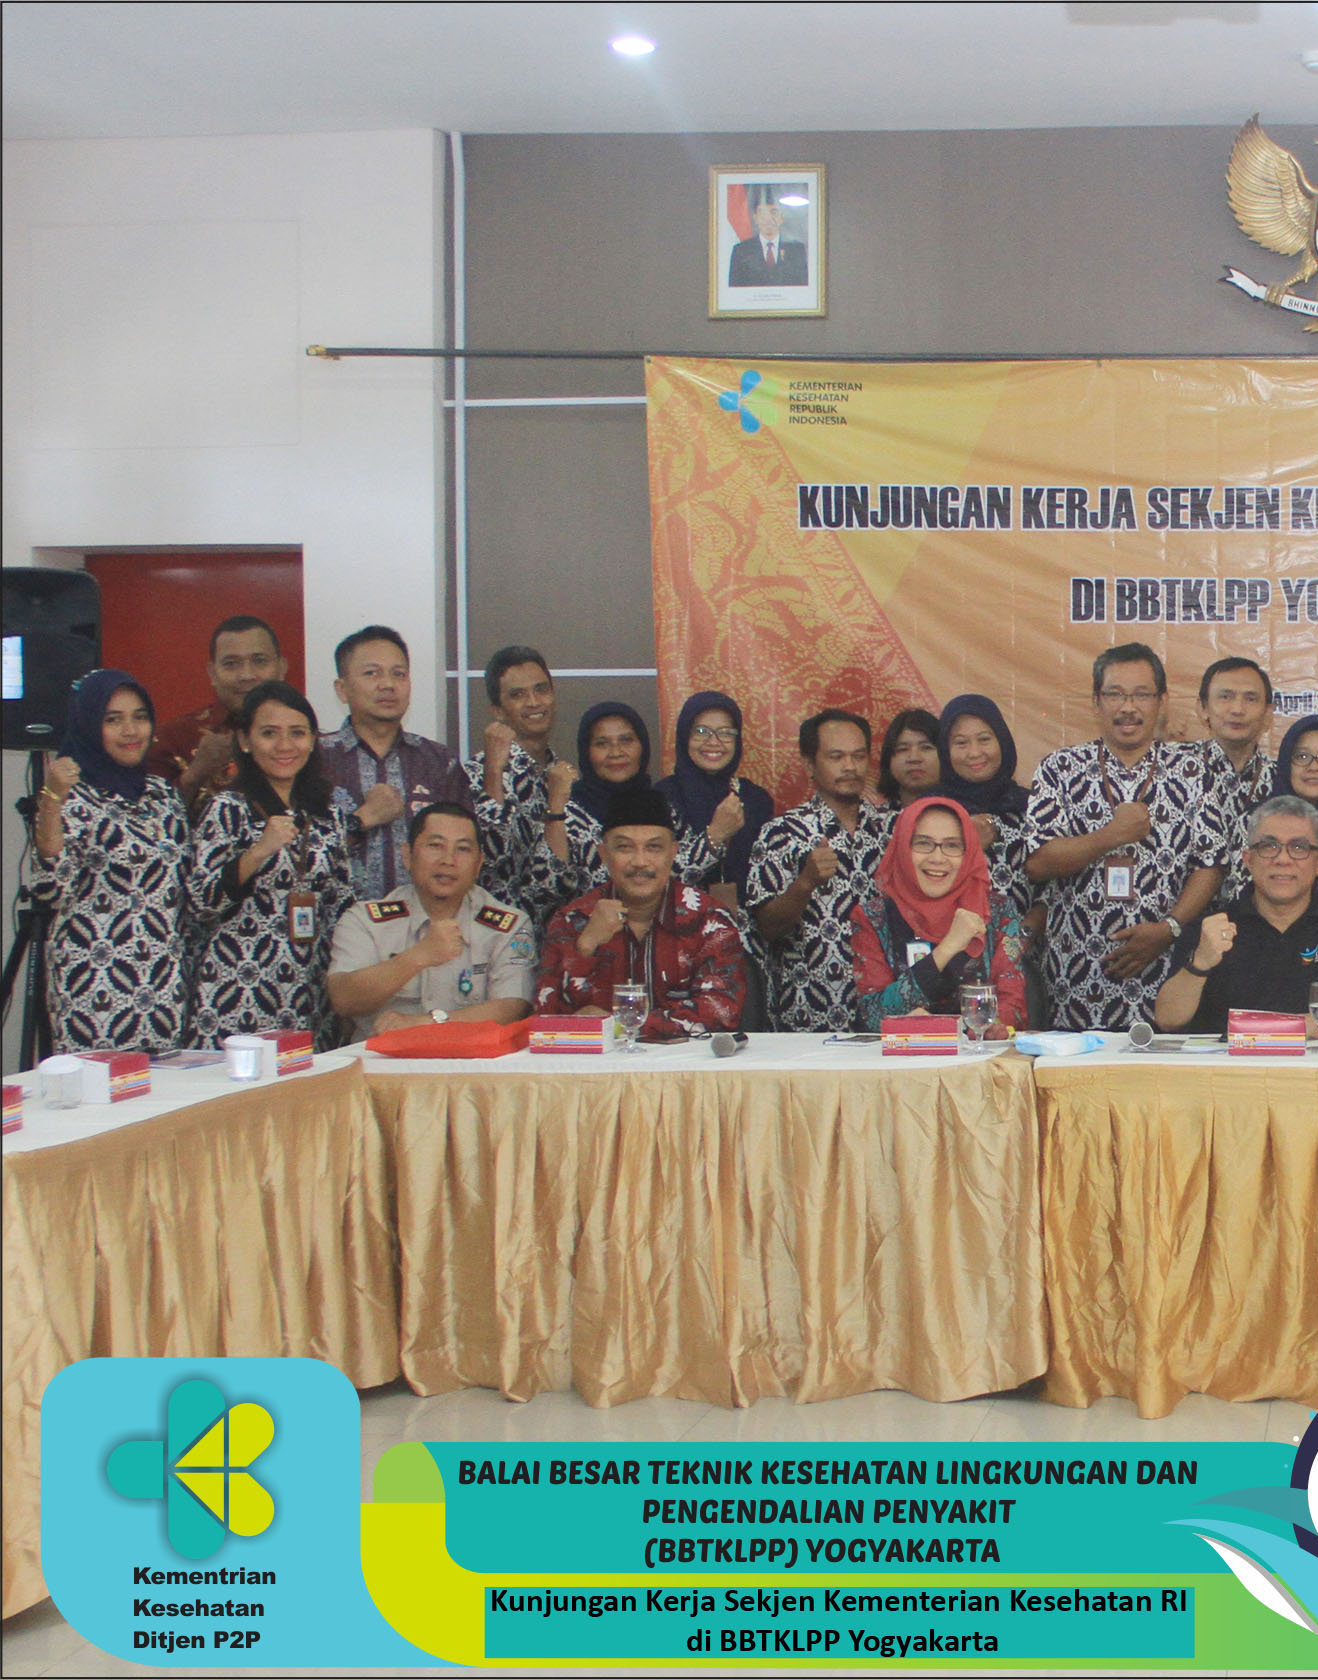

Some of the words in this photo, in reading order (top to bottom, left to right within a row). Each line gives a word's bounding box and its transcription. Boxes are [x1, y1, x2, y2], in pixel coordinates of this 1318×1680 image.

[789, 381, 863, 392] KEMENTERIAN
[789, 393, 849, 402] KESEHATAN
[789, 404, 838, 414] REPUBLIK
[789, 415, 848, 425] INDONESIA
[799, 484, 1012, 531] KUNJUNGAN
[1020, 485, 1138, 531] KERJA
[1146, 486, 1281, 531] SEKJEN
[1071, 577, 1106, 623] DI
[1114, 577, 1271, 623] BBTKLPP
[1273, 691, 1314, 715] April
